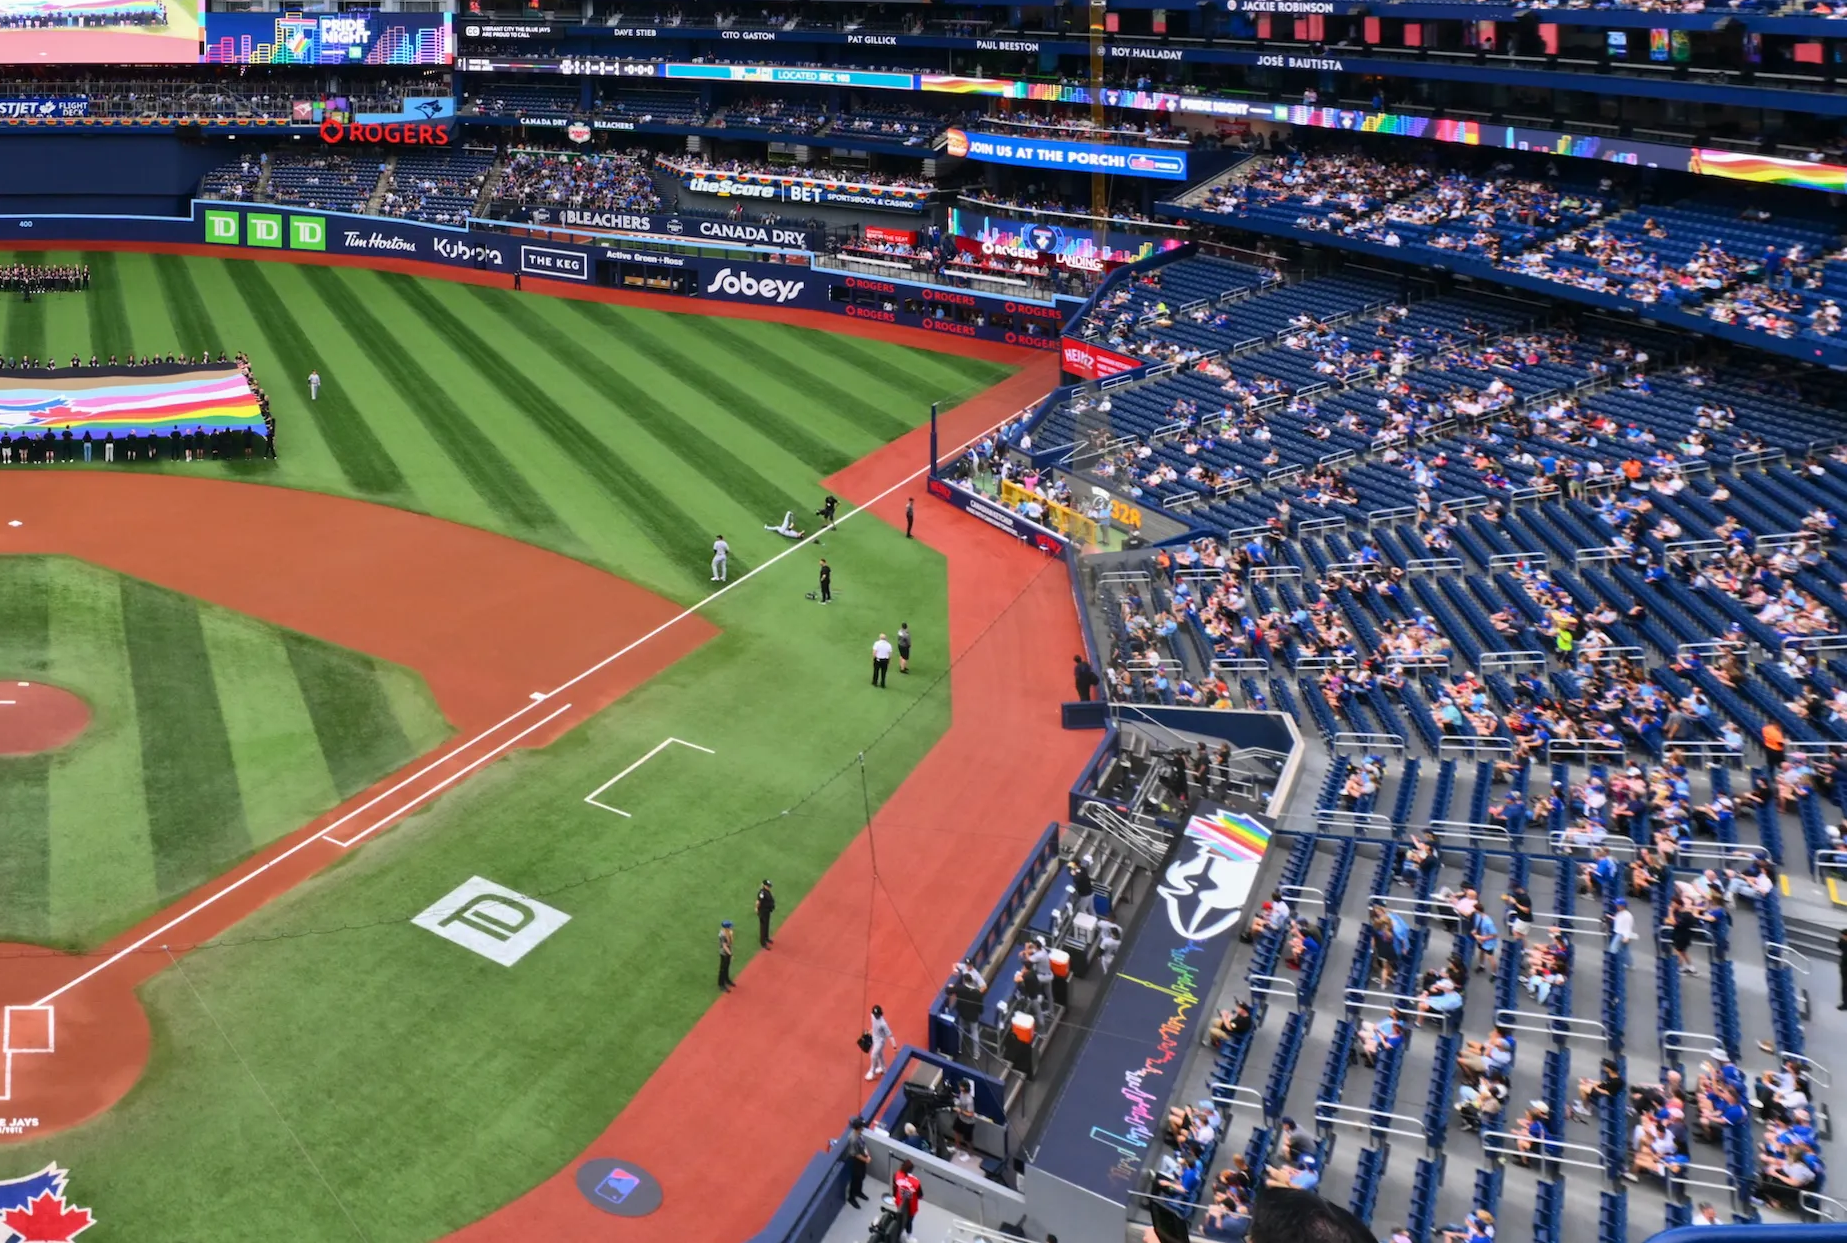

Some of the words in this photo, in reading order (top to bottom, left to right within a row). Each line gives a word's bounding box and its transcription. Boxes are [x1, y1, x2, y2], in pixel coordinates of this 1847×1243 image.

[1241, 0, 1276, 12] JACKIE
[1277, 1, 1334, 14] ROBINSON
[321, 19, 366, 32] PRIDE
[614, 28, 634, 37] DAVE
[636, 29, 657, 37] STIEB
[321, 31, 371, 44] NIGHT
[721, 31, 740, 40] CITO
[743, 31, 776, 41] GASTON
[847, 35, 863, 44] PAT
[864, 35, 897, 45] GILLICK
[976, 40, 998, 51] PAUL
[999, 41, 1039, 52] BEESTON
[1111, 46, 1131, 58] ROY
[1132, 47, 1183, 60] HALLADAY
[1257, 55, 1284, 67] JOSÉ
[1288, 58, 1343, 71] BAUTISTA
[777, 71, 817, 81] LOCATED
[58, 100, 88, 110] FLIGHT
[62, 108, 85, 117] DECK
[520, 118, 552, 126] CANADA
[552, 119, 568, 127] DRY
[593, 121, 635, 130] BLEACHERS
[349, 122, 449, 146] ROGERS
[969, 141, 993, 155] JOIN
[995, 144, 1013, 157] US
[1016, 147, 1034, 159] AT
[1037, 149, 1064, 163] THE
[1067, 152, 1126, 168] PORCH!
[689, 177, 775, 198] theScore
[790, 186, 822, 203] BET
[827, 192, 876, 205] SPORTSBOOK
[877, 196, 883, 206] &
[884, 198, 914, 209] CASINO
[18, 220, 33, 228] 400
[208, 216, 236, 238] TD
[566, 210, 651, 231] BLEACHERS
[250, 219, 279, 240] TD
[293, 221, 322, 244] TD
[699, 221, 770, 242] CANADA
[772, 228, 806, 246] DRY
[343, 231, 367, 248] Tim
[368, 231, 417, 253] Hortons
[606, 250, 632, 261] Active
[995, 244, 1039, 260] ROGERS
[528, 254, 552, 267] THE
[556, 258, 580, 270] KEG
[1055, 253, 1103, 271] LANDING
[707, 267, 805, 303] Sobeys
[856, 280, 896, 294] ROGERS
[933, 290, 976, 306] ROGERS
[856, 308, 896, 323] ROGERS
[1017, 303, 1062, 320] ROGERS
[933, 320, 976, 336] ROGERS
[1064, 348, 1095, 370] HEINZ
[437, 893, 536, 943] TD
[8, 1117, 40, 1127] JAYS
